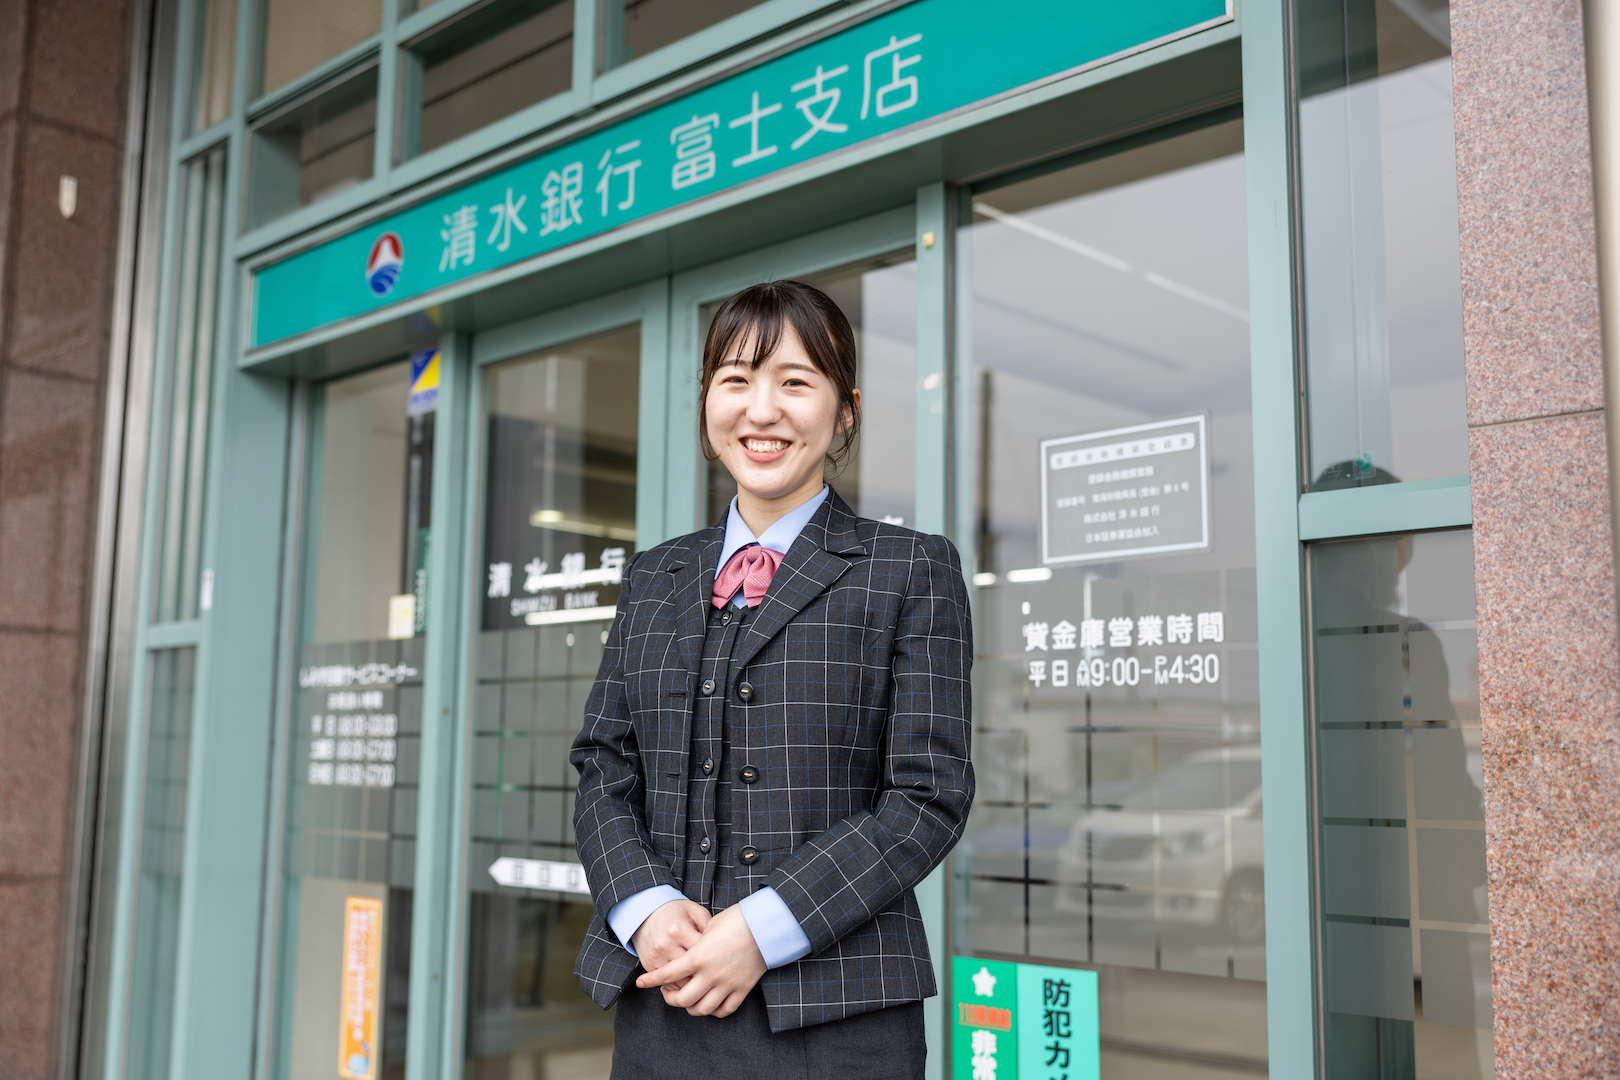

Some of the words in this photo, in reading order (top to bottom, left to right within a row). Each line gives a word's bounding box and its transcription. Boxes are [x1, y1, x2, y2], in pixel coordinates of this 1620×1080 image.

[438, 140, 642, 272] 清水銀行
[670, 33, 923, 190] 富士支店
[488, 547, 626, 598] 清水銀行
[563, 590, 600, 611] BANK
[1025, 611, 1224, 652] 貸金庫営業時間
[1043, 978, 1072, 1080] 防犯カ
